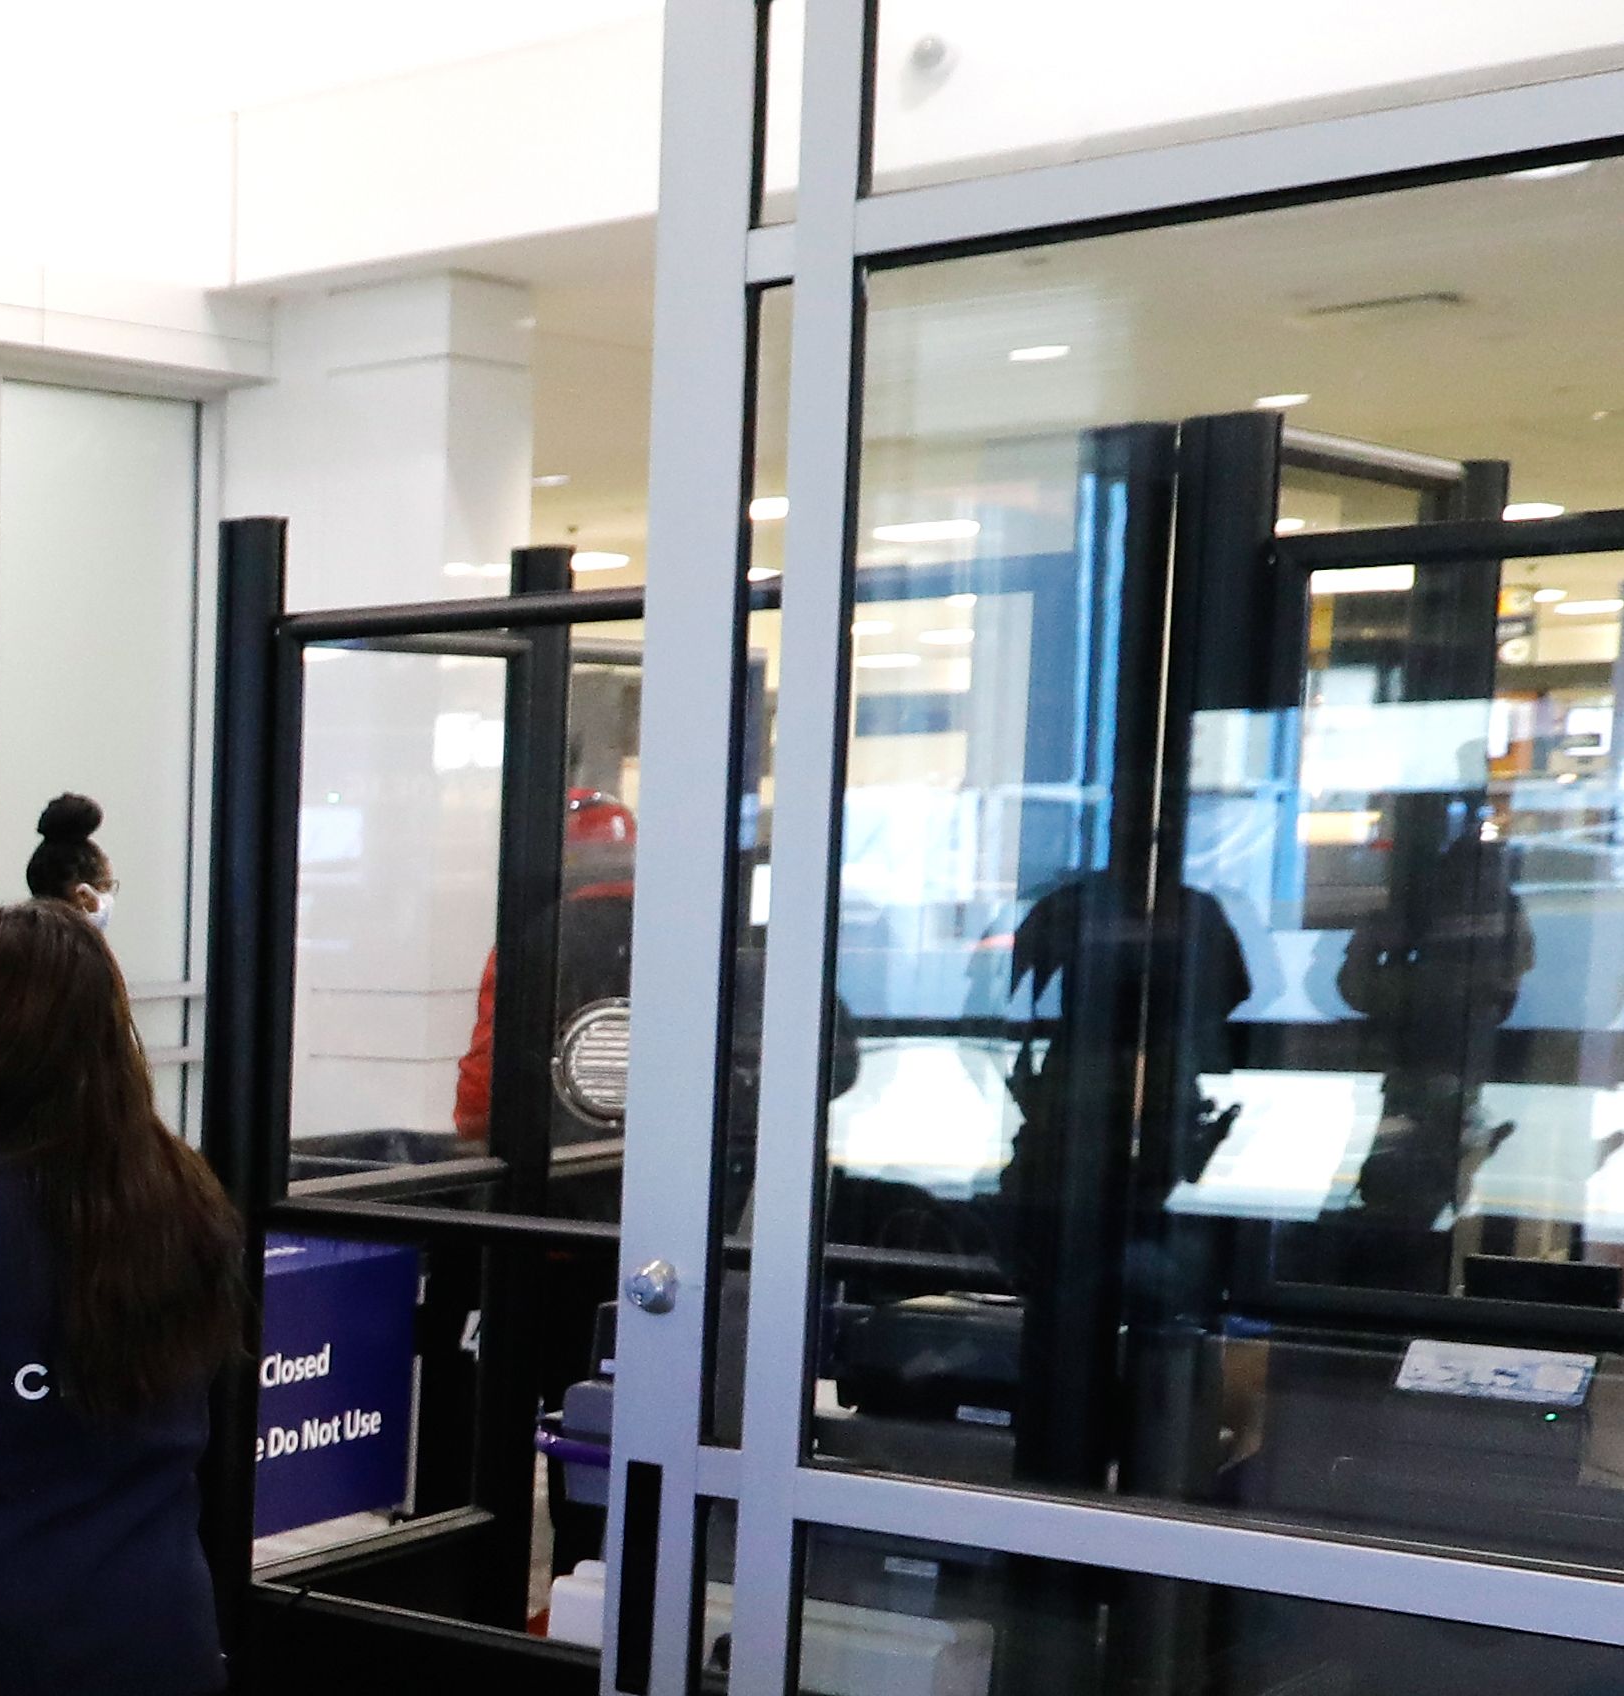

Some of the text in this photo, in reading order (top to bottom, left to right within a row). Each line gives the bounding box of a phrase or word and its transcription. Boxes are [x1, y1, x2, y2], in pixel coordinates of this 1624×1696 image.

[259, 1342, 332, 1388] Closed
[267, 1426, 299, 1459] Do
[302, 1415, 341, 1451] Not
[344, 1408, 382, 1442] Use
